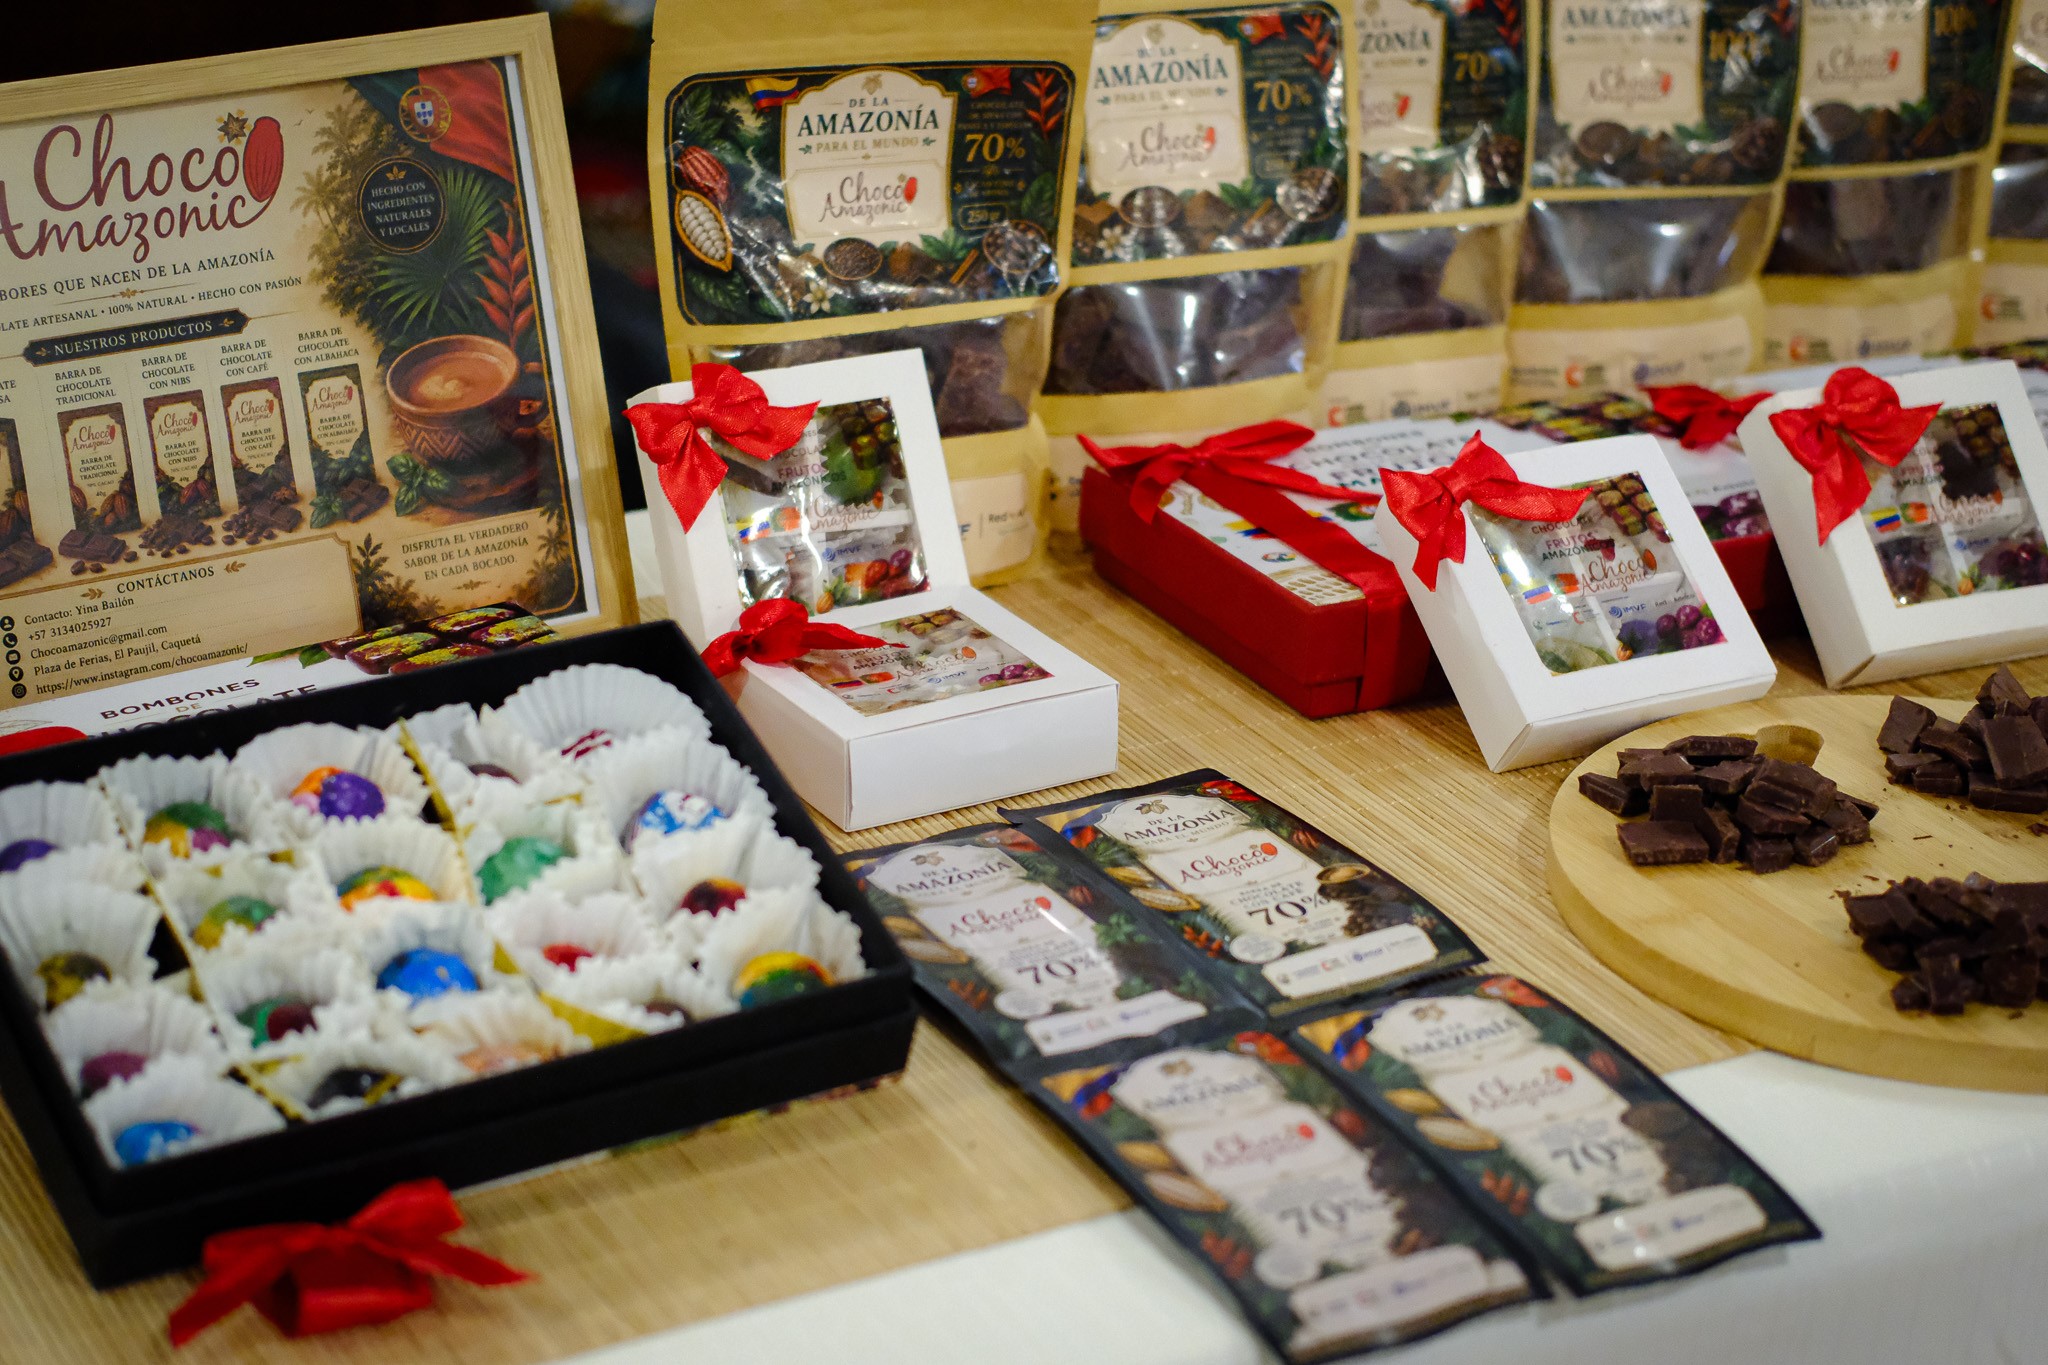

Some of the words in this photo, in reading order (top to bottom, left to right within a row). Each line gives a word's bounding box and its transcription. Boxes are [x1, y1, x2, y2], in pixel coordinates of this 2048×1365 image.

[1094, 54, 1228, 89] AMAZONÍA
[848, 98, 865, 108] DE
[872, 97, 889, 106] LA
[1254, 80, 1313, 113] 70%
[797, 104, 939, 137] AMAZONÍA
[816, 141, 848, 152] PARA
[852, 140, 868, 150] EL
[872, 136, 919, 149] MUNDO
[1141, 121, 1201, 153] Choco
[965, 133, 1026, 162] 70%
[33, 113, 240, 212] Choco
[371, 185, 404, 198] HECHO
[406, 182, 426, 192] CON
[839, 171, 904, 204] Choco
[367, 193, 435, 211] INGREDIENTES
[818, 192, 906, 224] Amazonic
[375, 208, 432, 223] NATURALES
[380, 227, 386, 237] Y
[389, 222, 431, 236] LOCALES
[53, 278, 86, 295] QUE
[91, 270, 142, 288] NACEN
[147, 266, 167, 279] DE
[172, 263, 192, 276] LA
[197, 248, 276, 272] AMAZONÍA
[33, 308, 98, 326] ARTESANAL
[108, 302, 134, 316] 100%
[136, 294, 188, 312] NATURAL
[198, 287, 237, 302] HECHO
[239, 283, 263, 296] CON
[265, 276, 302, 292] PASIÓN
[53, 334, 127, 357] NUESTROS
[131, 320, 213, 344] PRODUCTOS
[299, 329, 328, 341] BARRA
[331, 327, 343, 336] DE
[221, 341, 251, 355] BARRA
[254, 339, 267, 349] DE
[297, 338, 350, 353] CHOCOLATE
[141, 354, 172, 368] BARRA
[174, 352, 188, 363] DE
[219, 351, 273, 367] CHOCOLATE
[294, 357, 313, 367] CON
[314, 348, 360, 363] ALBAHACA
[55, 369, 87, 382] BARRA
[88, 366, 103, 377] DE
[141, 363, 196, 380] CHOCOLATE
[226, 367, 245, 378] CON
[246, 361, 269, 375] CAFÉ
[55, 377, 112, 394] CHOCOLATE
[149, 379, 168, 391] CON
[171, 376, 192, 387] NIBS
[55, 389, 117, 406] TRADICIONAL
[163, 412, 193, 429] Choco
[79, 425, 110, 443] Choco
[155, 424, 196, 440] Amazonic
[240, 434, 277, 446] CHOCOLATE
[241, 429, 263, 438] BARRA
[70, 437, 114, 454] Amazonic
[163, 447, 200, 459] CHOCOLATE
[164, 442, 187, 451] BARRA
[79, 461, 117, 473] CHOCOLATE
[81, 456, 103, 466] BARRA
[168, 458, 182, 466] CON
[80, 469, 119, 481] TRADICIONAL
[402, 536, 451, 555] DISFRUTA
[454, 534, 467, 545] EL
[469, 521, 529, 541] VERDADERO
[404, 552, 438, 569] SABOR
[441, 550, 456, 562] DE
[457, 548, 471, 559] LA
[474, 537, 529, 556] AMAZONÍA
[424, 571, 438, 580] EN
[441, 564, 469, 577] CADA
[473, 554, 517, 571] BOCADO.
[1588, 554, 1646, 582] Choco
[116, 565, 216, 594] CONTÁCTANOS
[1579, 569, 1654, 597] Amazonic
[24, 608, 74, 626] Contacto:
[75, 603, 100, 616] Yina
[101, 595, 135, 612] Bailón
[1622, 602, 1647, 614] IMVF
[27, 629, 47, 642] +57
[49, 616, 112, 638] 3134025927
[30, 624, 168, 660] Chocoamazonic@gmail.com
[34, 662, 62, 677] Plaza
[64, 658, 77, 671] de
[79, 652, 113, 669] Ferias,
[114, 649, 125, 661] El
[127, 641, 159, 661] Paujil,
[161, 633, 202, 654] Caquetá
[36, 643, 248, 696] https://www.instagram.com/chocoamazonic/
[100, 678, 261, 720] BOMBONES
[174, 702, 203, 714] DE
[1124, 808, 1235, 842] AMAZONÍA
[1148, 818, 1163, 827] DE
[1171, 814, 1186, 822] LA
[1181, 853, 1277, 884] Amazonic
[1190, 849, 1263, 875] Choco
[895, 859, 1012, 895] AMAZONÍA
[962, 901, 1038, 928] Choco
[1248, 894, 1331, 926] 70%
[1016, 952, 1099, 985] 70%
